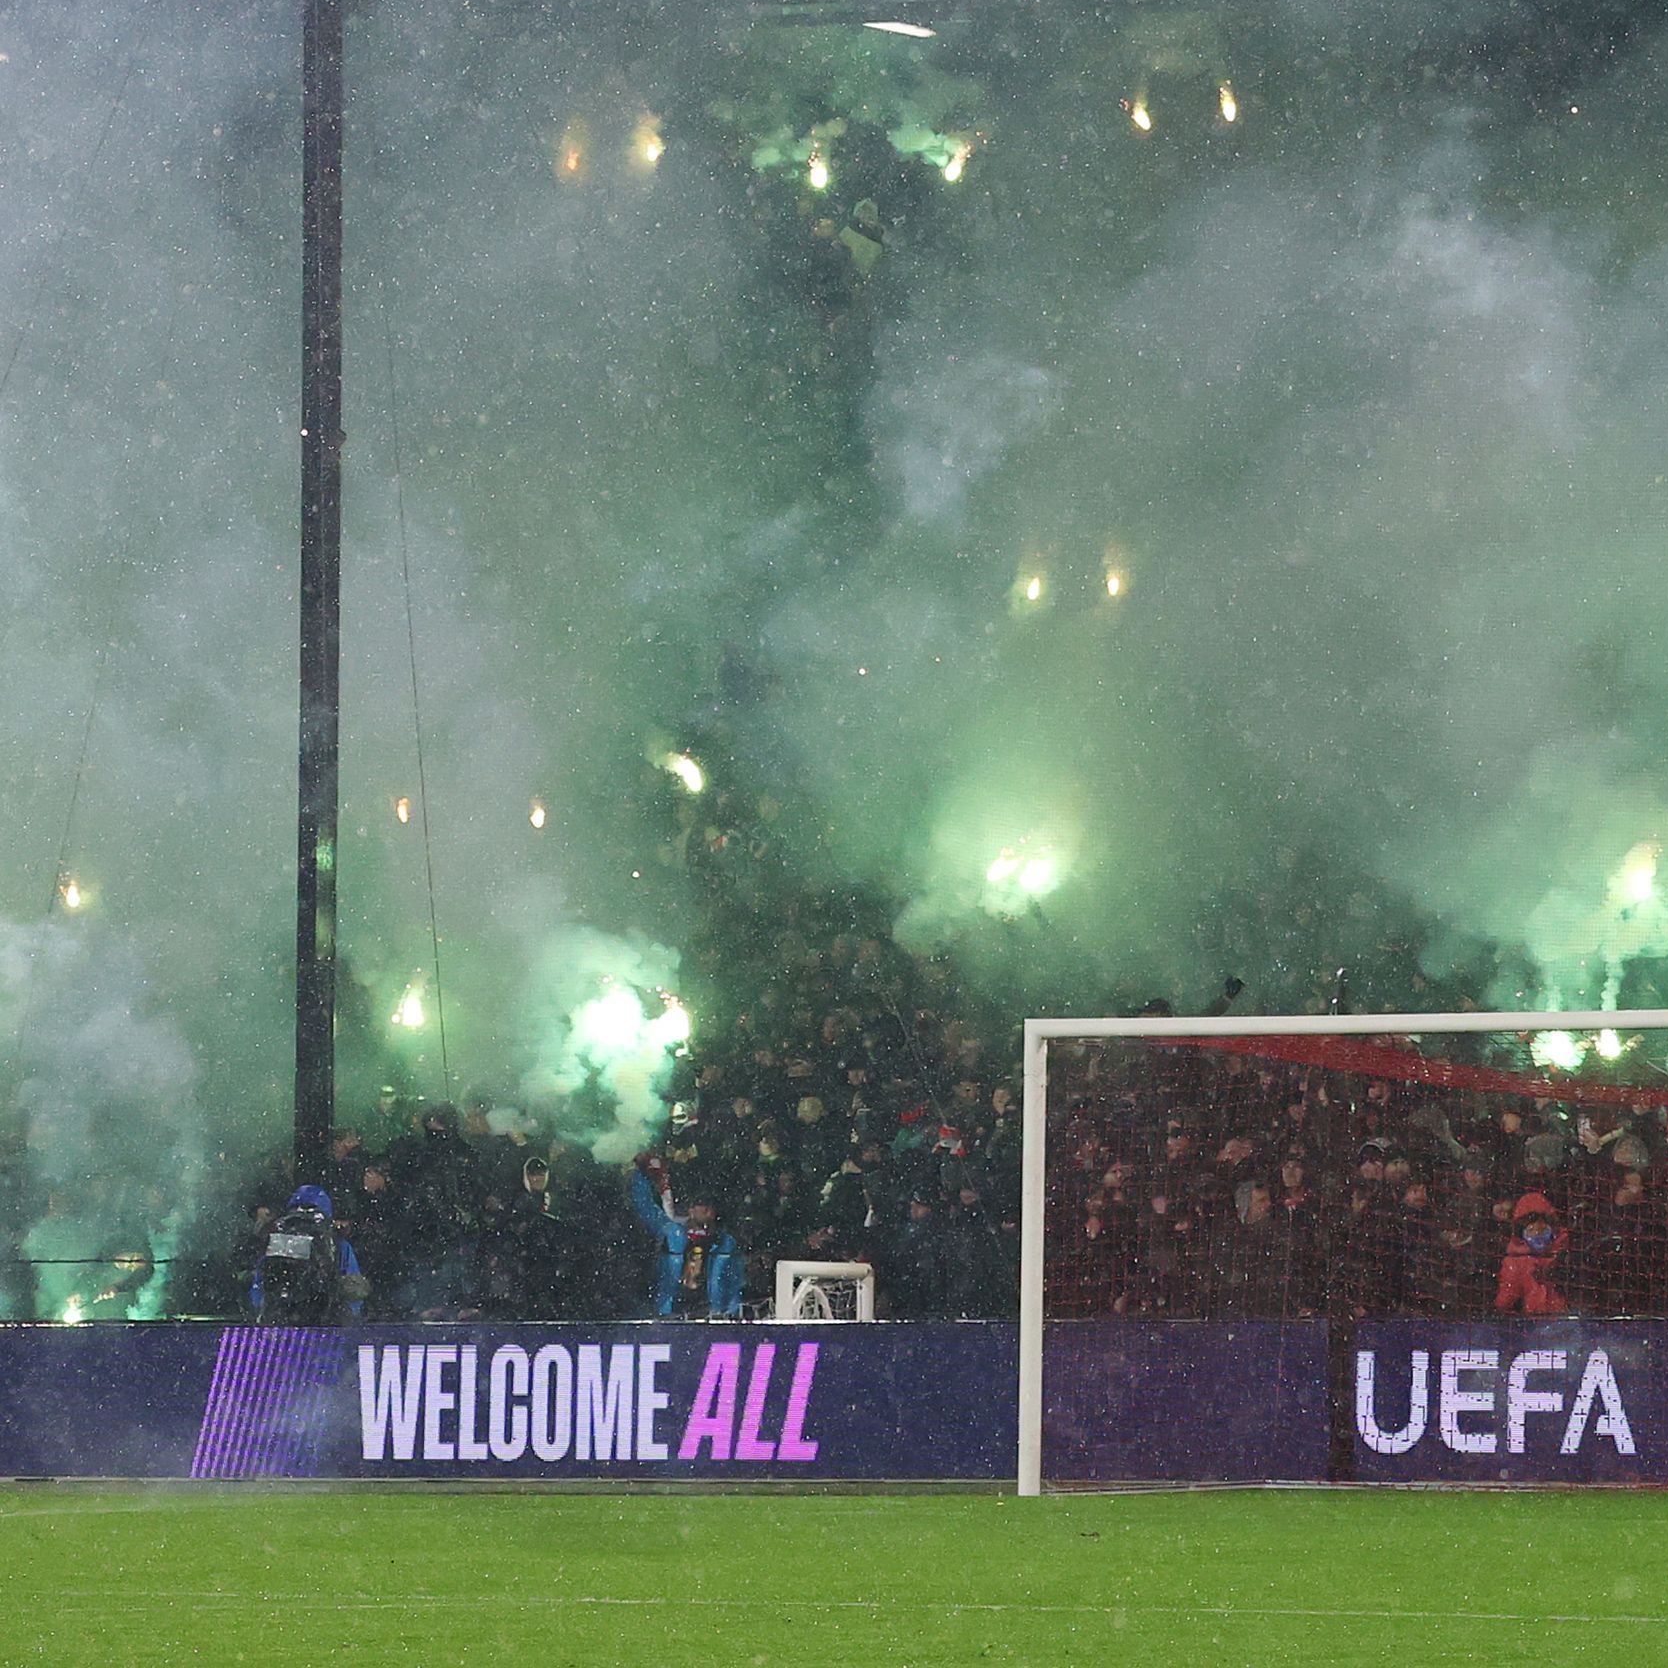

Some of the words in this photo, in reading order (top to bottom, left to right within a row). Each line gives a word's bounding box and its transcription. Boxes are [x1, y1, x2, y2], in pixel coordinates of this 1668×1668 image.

[357, 1343, 671, 1462] WELCOME
[678, 1342, 819, 1462] ALL
[1355, 1349, 1637, 1455] UEFA
